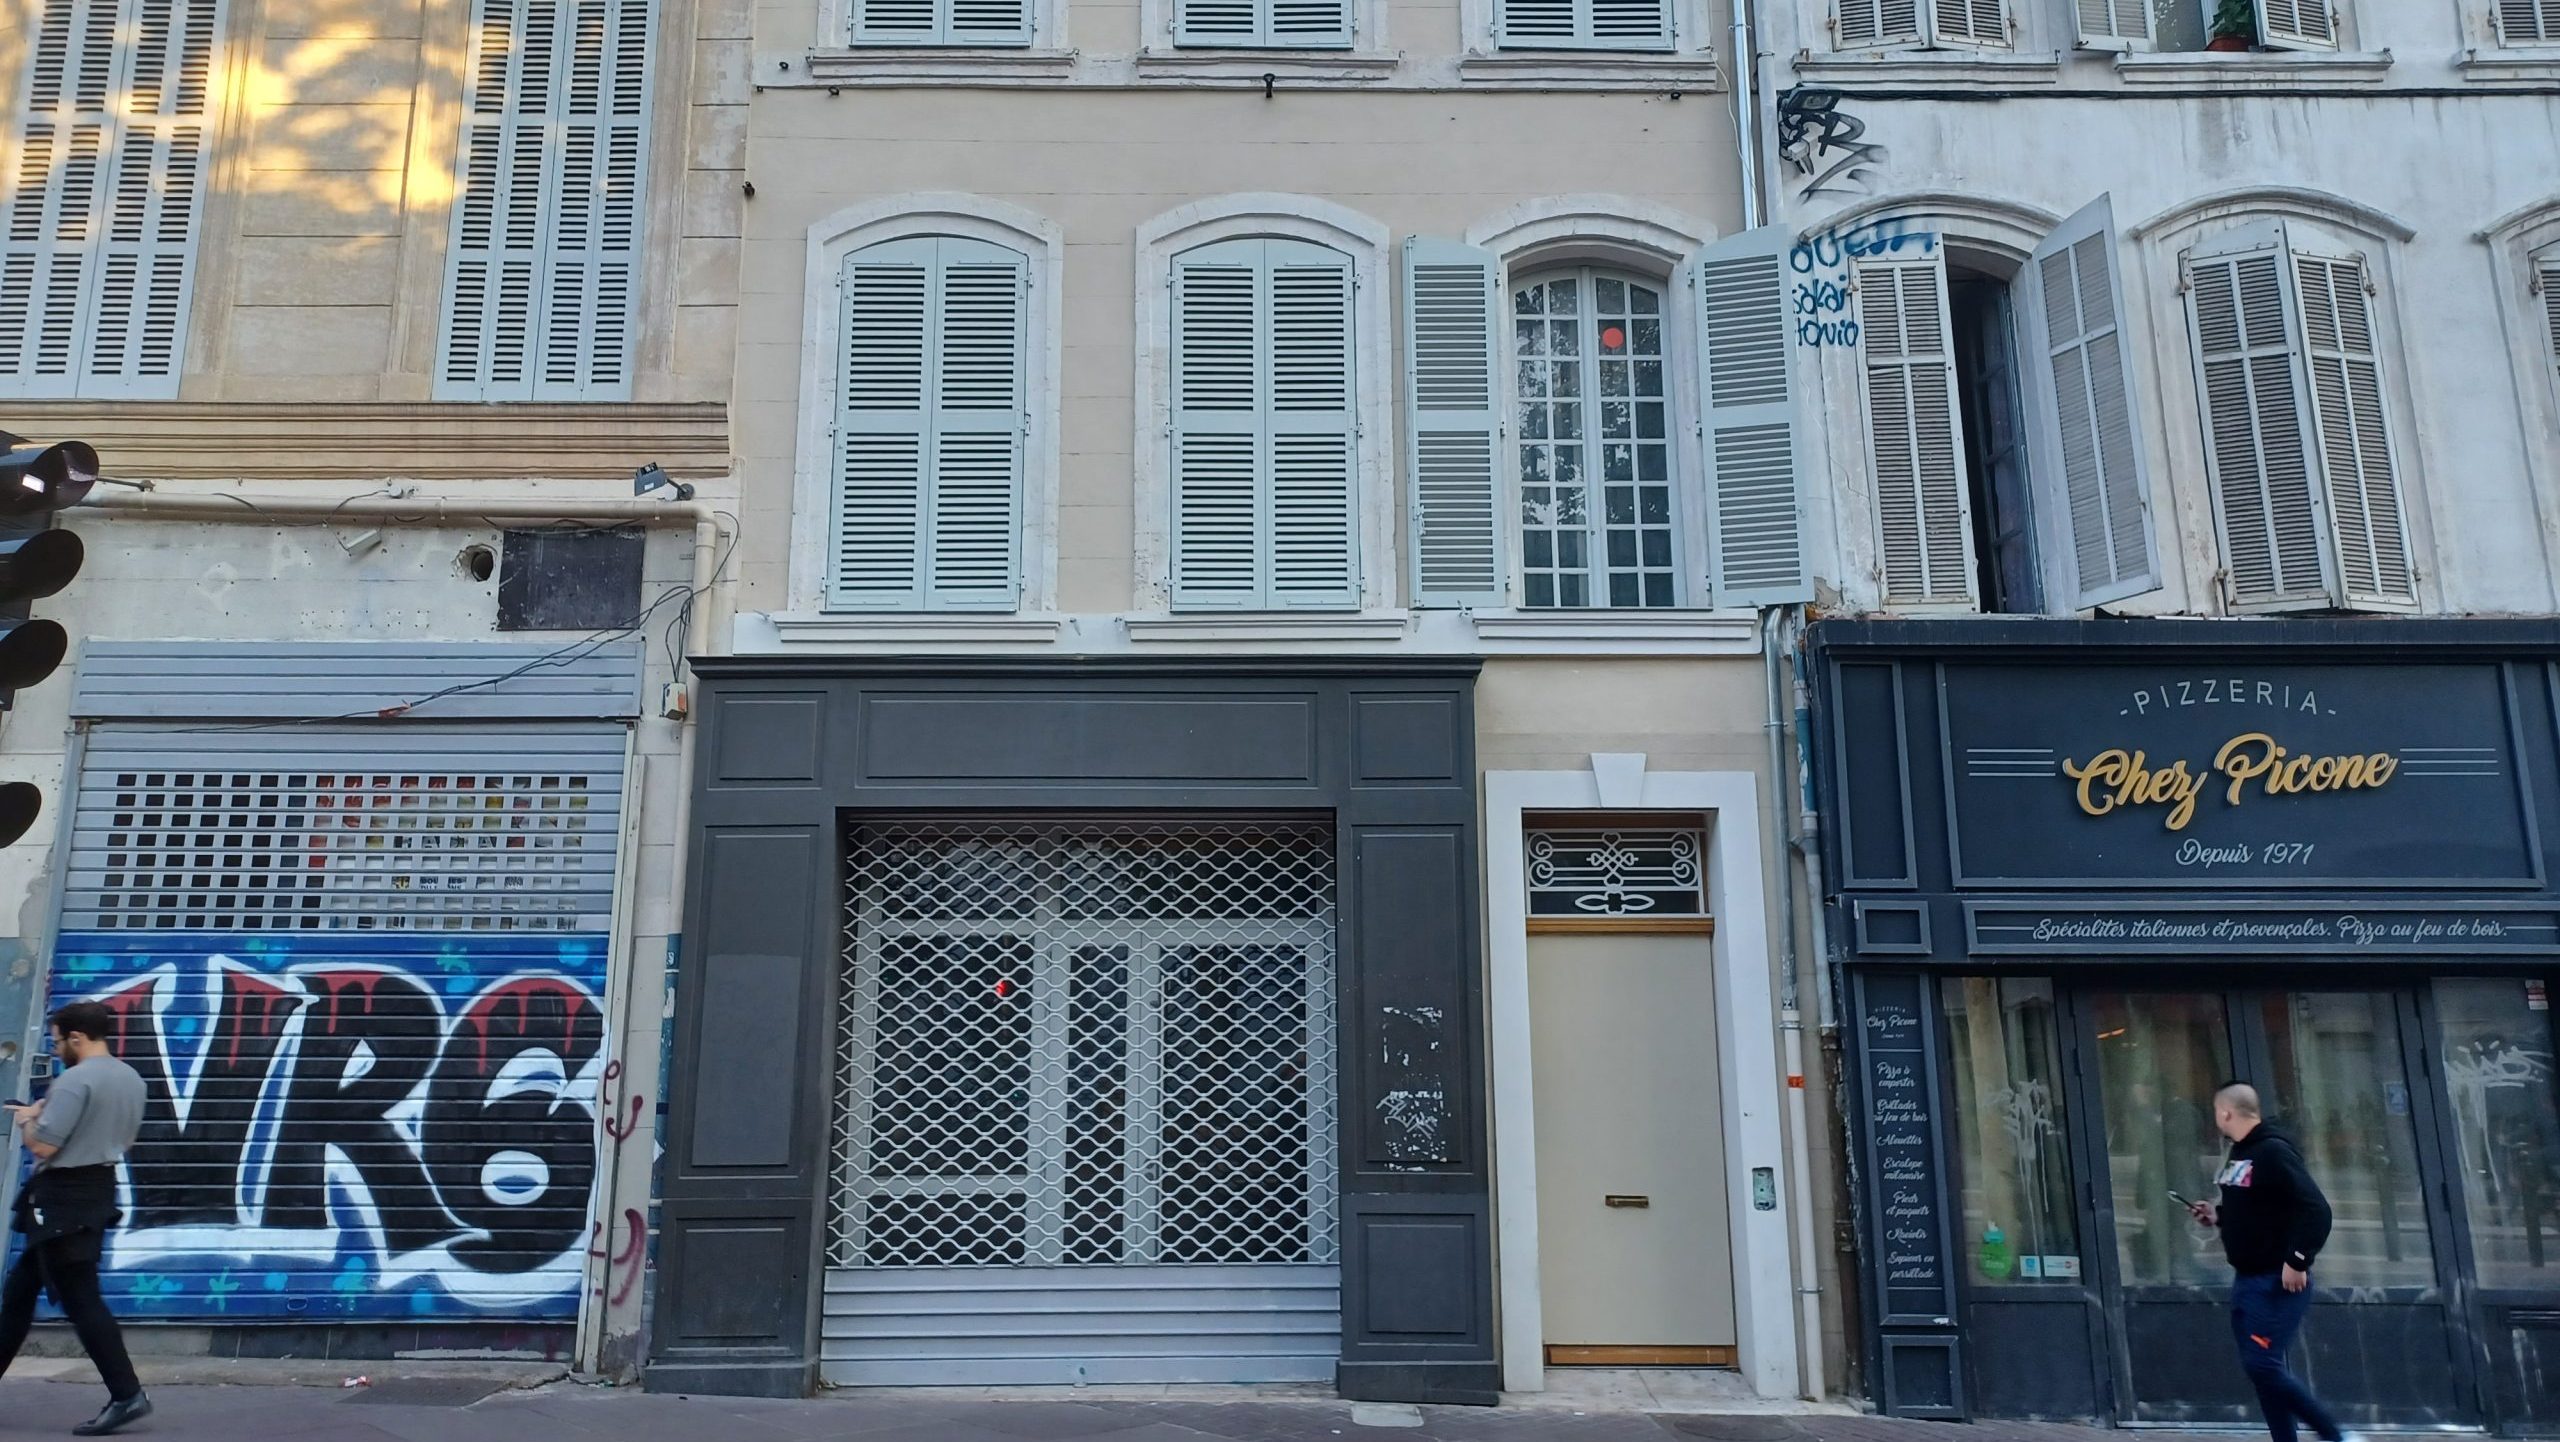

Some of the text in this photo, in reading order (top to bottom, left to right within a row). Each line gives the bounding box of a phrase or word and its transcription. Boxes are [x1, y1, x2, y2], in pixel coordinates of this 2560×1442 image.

[2062, 732, 2398, 831] Chez Picone
[2175, 838, 2315, 868] Depuis 1971
[2033, 918, 2129, 941] Spécialités
[2130, 919, 2211, 937] italiennes
[2212, 919, 2231, 937] et
[2337, 915, 2387, 944] Pizza
[2390, 923, 2414, 937] au
[2413, 919, 2444, 943] feu
[2447, 919, 2469, 937] de
[1866, 1015, 1887, 1031] Chez
[1877, 1061, 1902, 1079] Pizza
[1900, 1111, 1911, 1121] de
